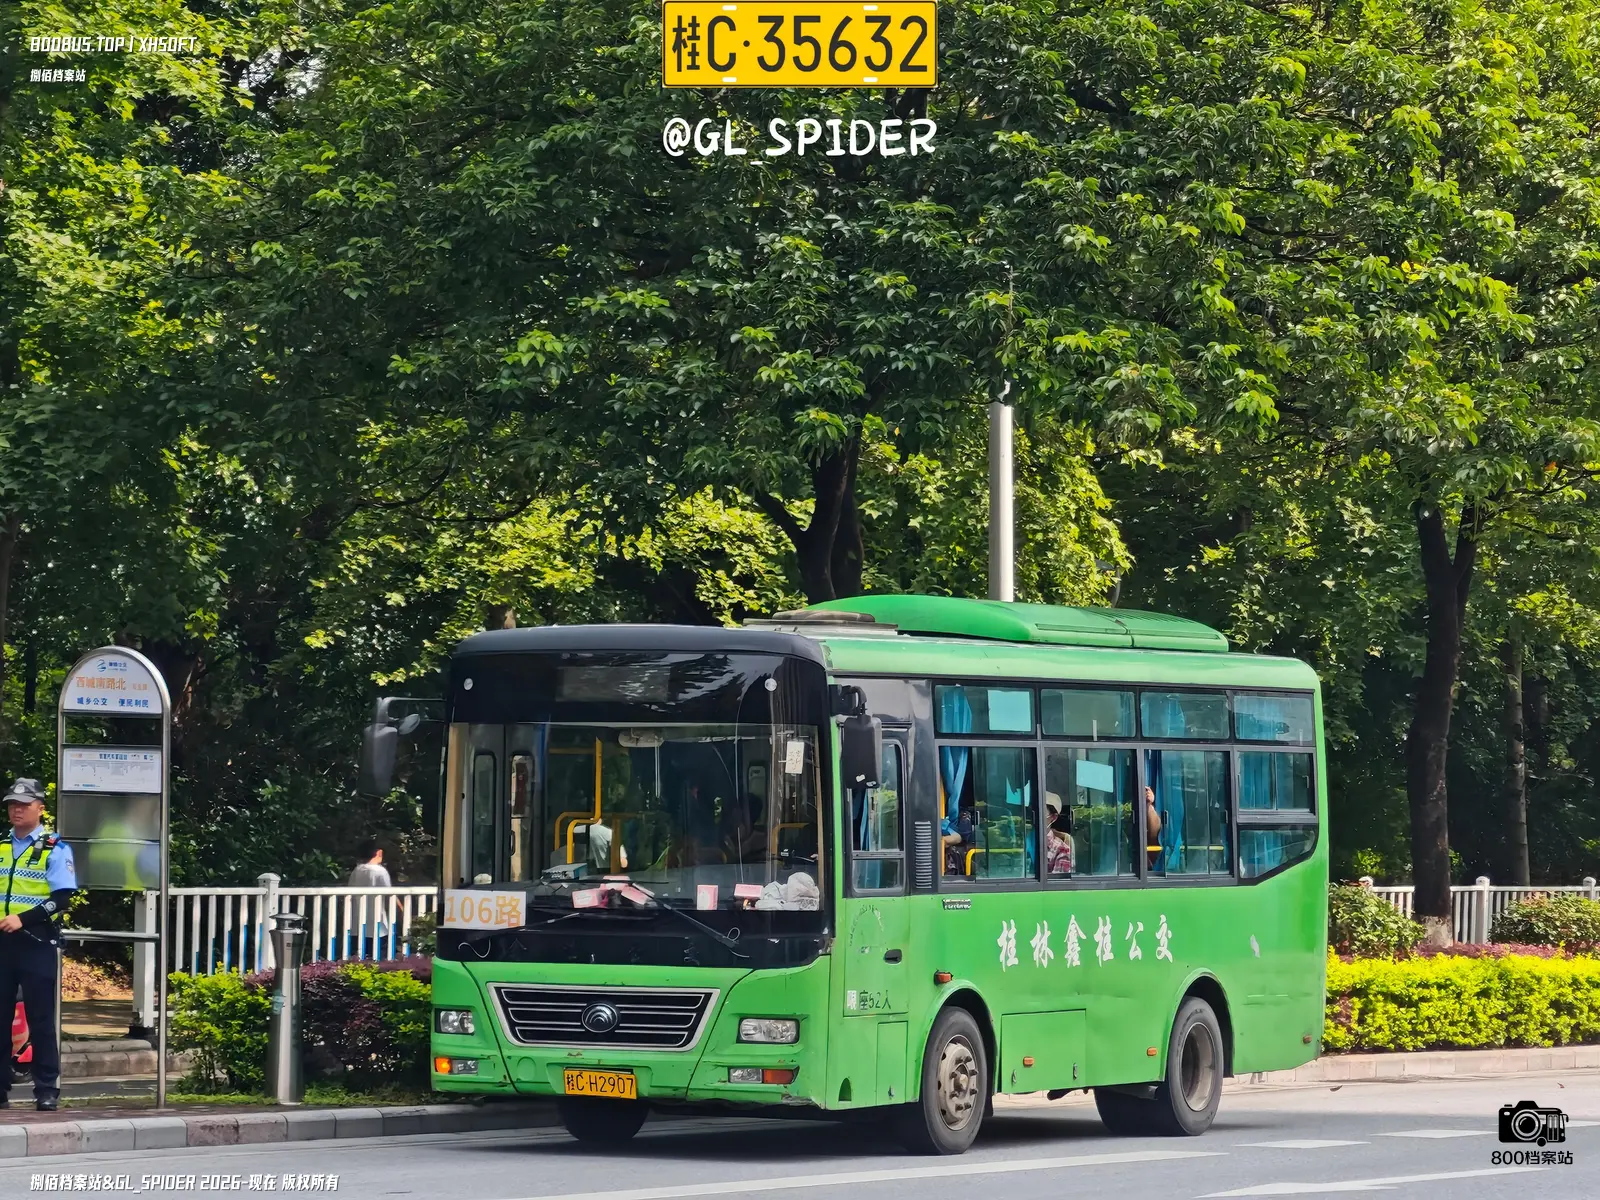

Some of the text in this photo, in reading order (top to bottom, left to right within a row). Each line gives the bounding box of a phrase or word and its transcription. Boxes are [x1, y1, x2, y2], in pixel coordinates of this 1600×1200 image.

[76, 676, 127, 691] 西城南路北
[77, 697, 149, 708] 城乡公交 便民利民
[445, 895, 522, 928] 106路
[997, 914, 1173, 973] 桂林鑫桂公交
